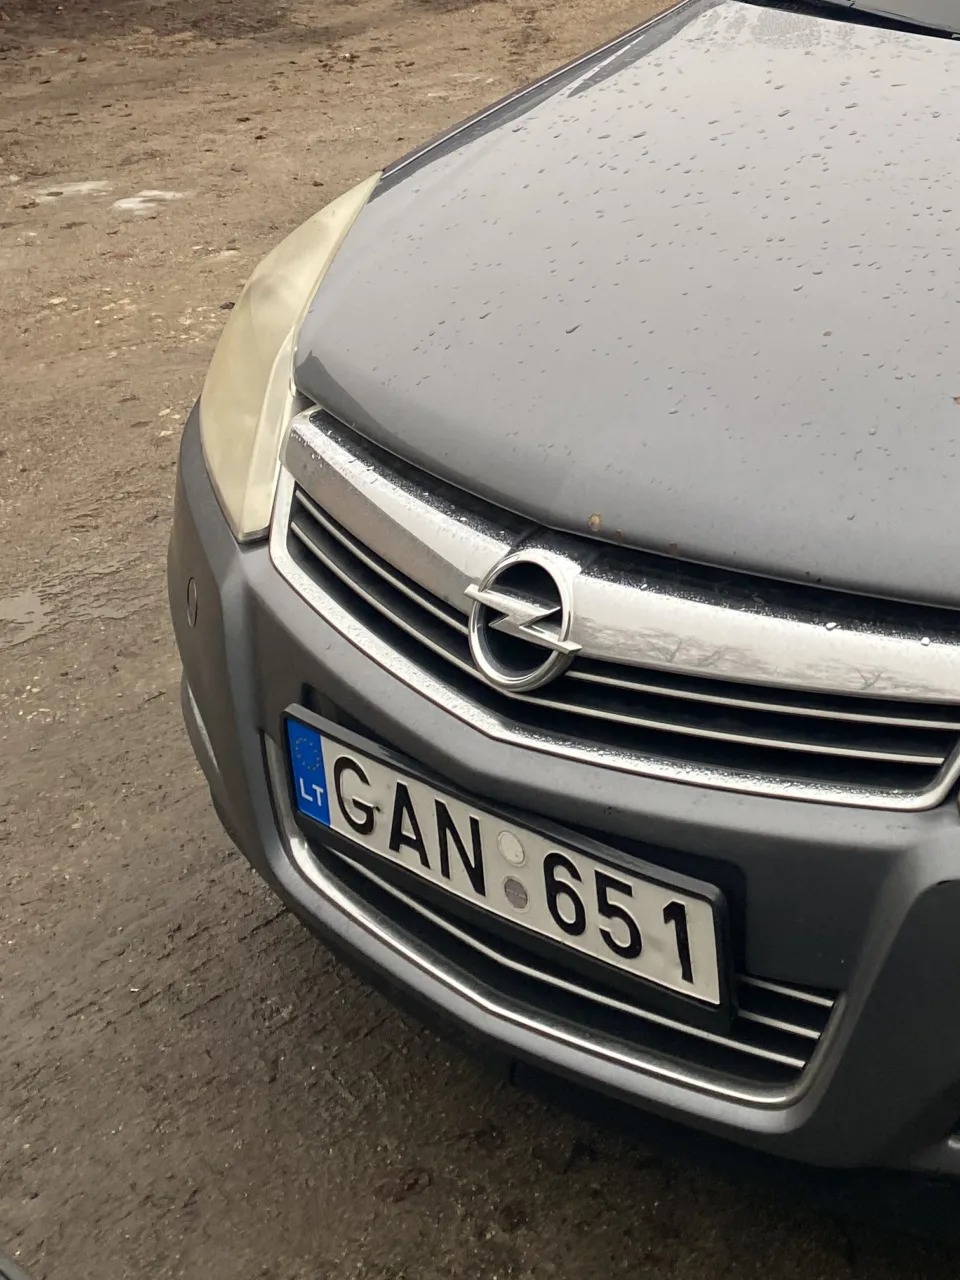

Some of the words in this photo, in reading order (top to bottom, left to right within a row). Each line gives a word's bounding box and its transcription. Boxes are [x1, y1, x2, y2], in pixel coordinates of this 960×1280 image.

[300, 777, 324, 806] LT
[333, 756, 486, 897] GAN
[543, 852, 694, 984] 651
